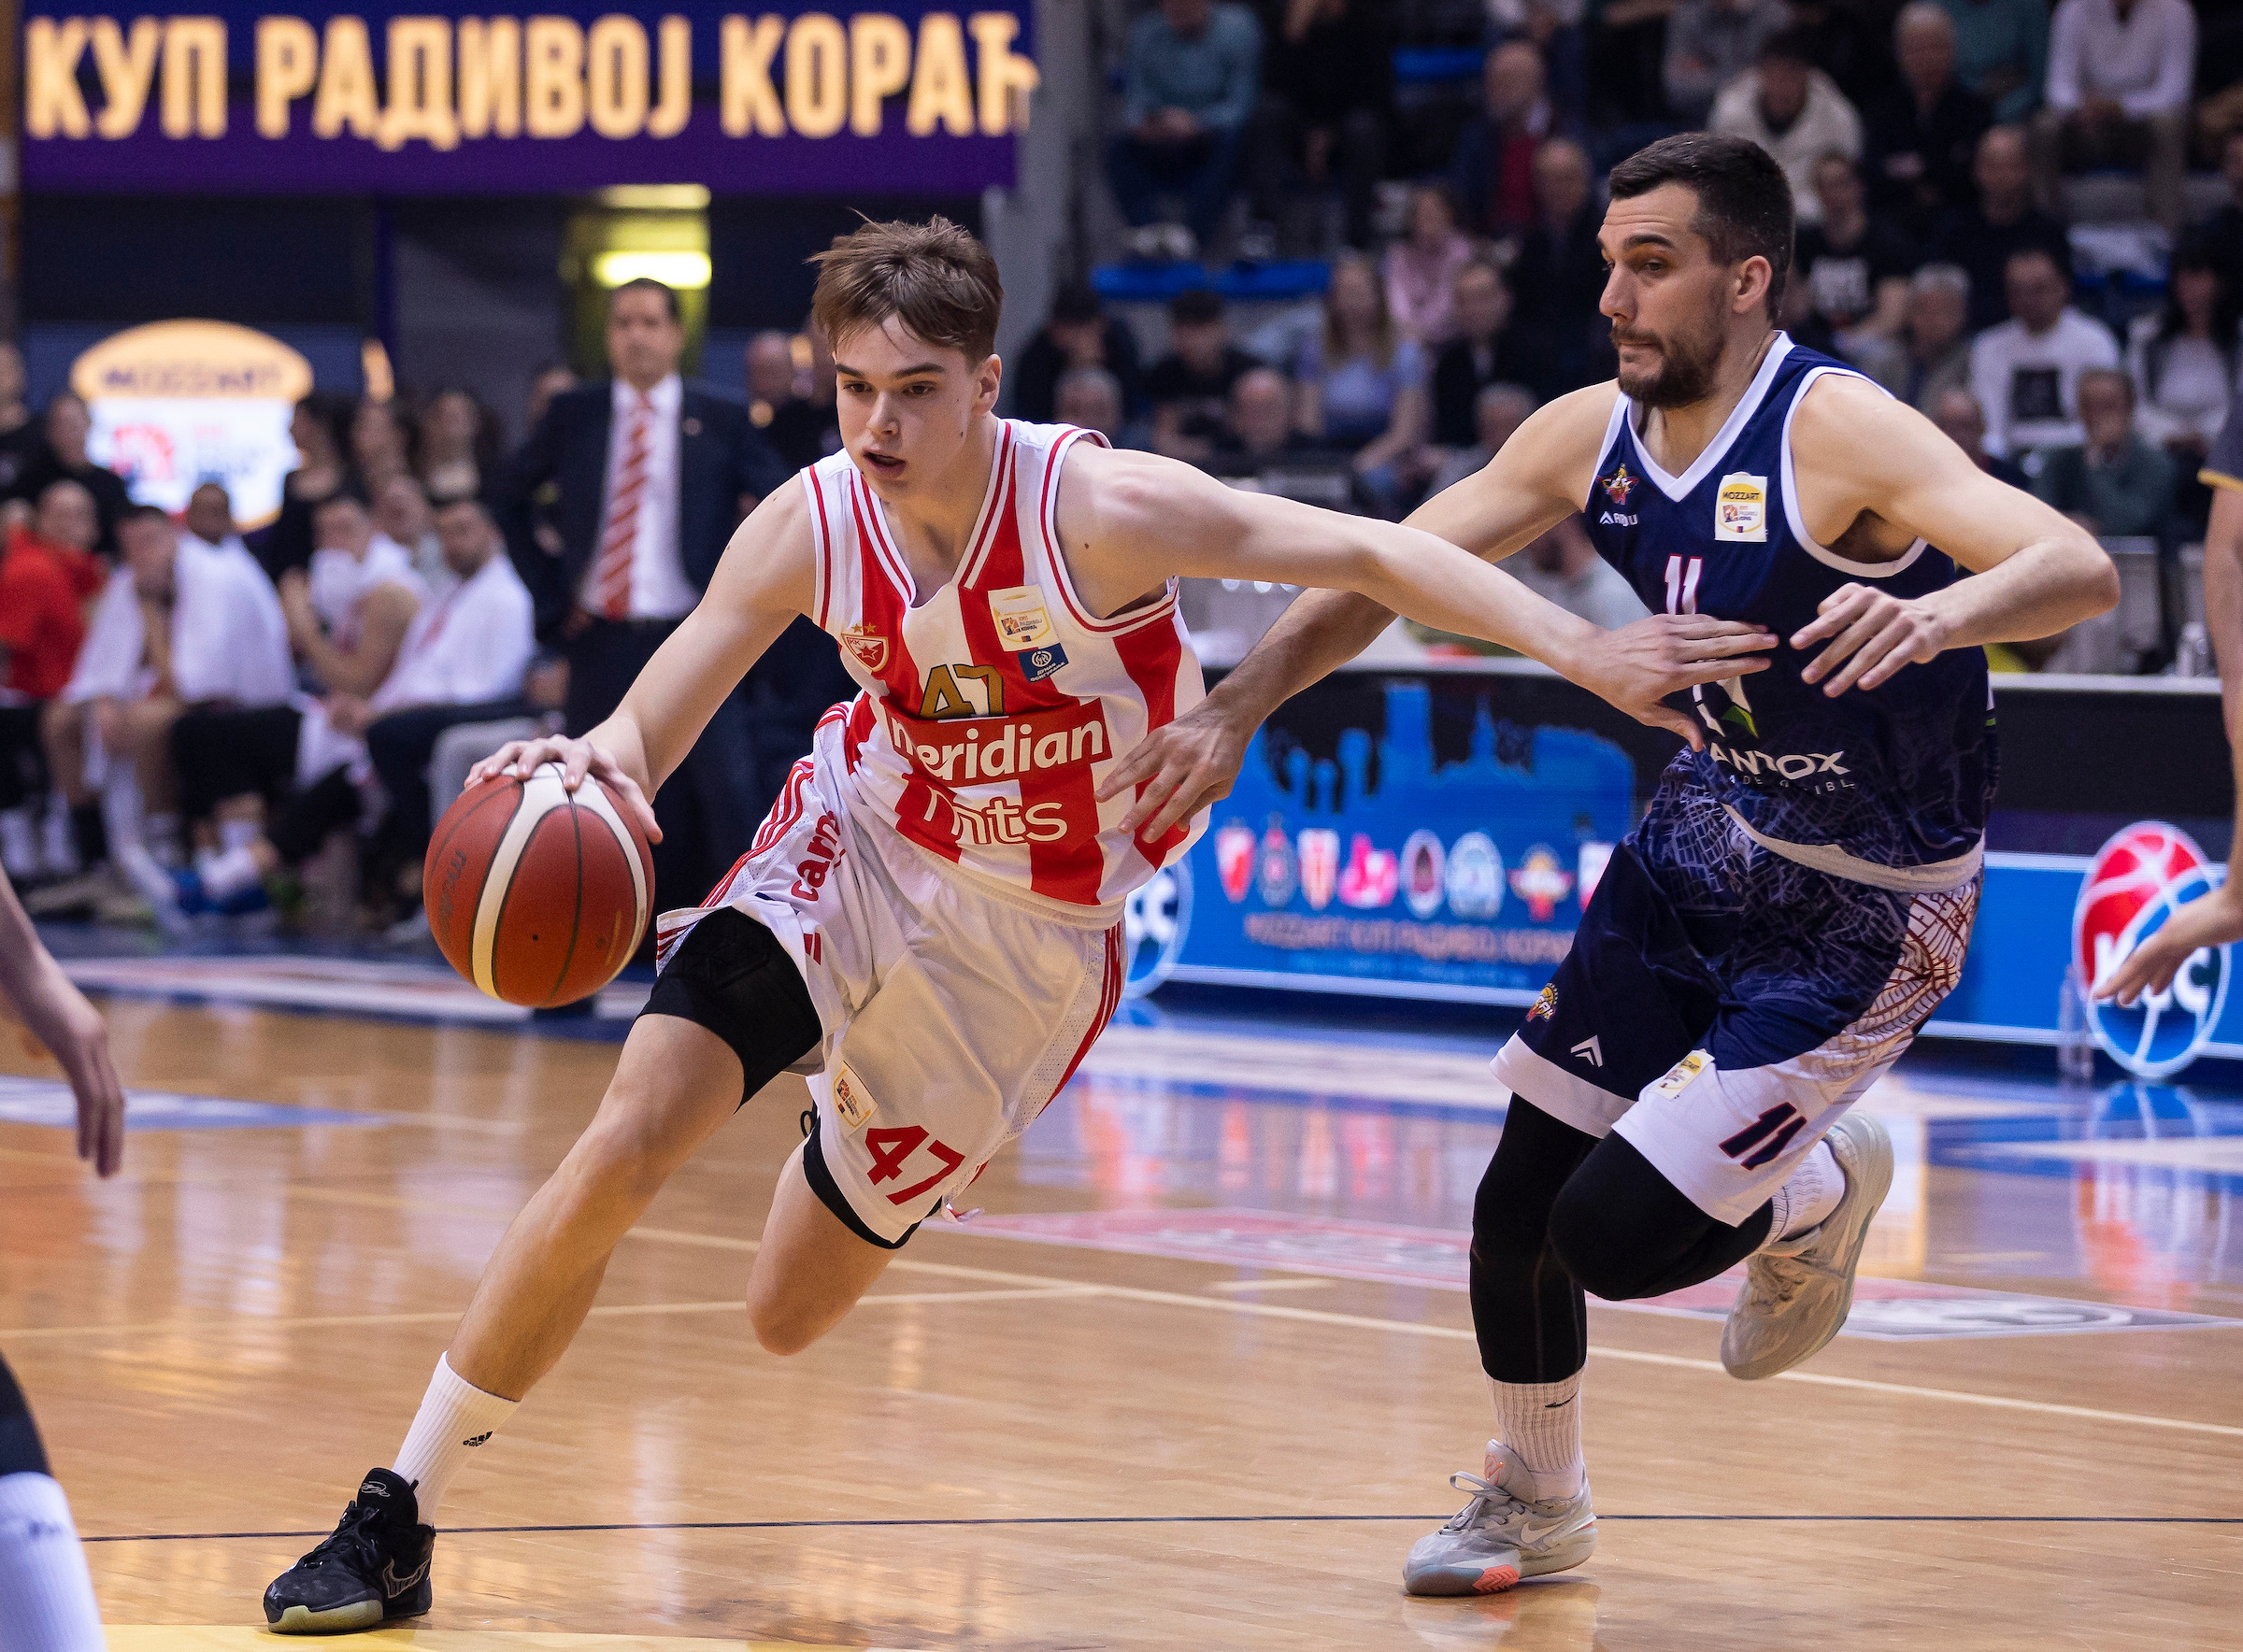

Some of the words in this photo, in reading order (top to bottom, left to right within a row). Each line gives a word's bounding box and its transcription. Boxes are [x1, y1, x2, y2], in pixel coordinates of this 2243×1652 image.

[25, 13, 228, 139] КУП
[254, 13, 693, 152] РАДИВОЈ
[721, 11, 1039, 139] КОРАЋ
[1722, 491, 1760, 501] MOZZART
[1663, 553, 1703, 615] 11
[919, 663, 1005, 719] 47
[866, 1125, 966, 1205] 47
[1719, 1102, 1807, 1171] 11
